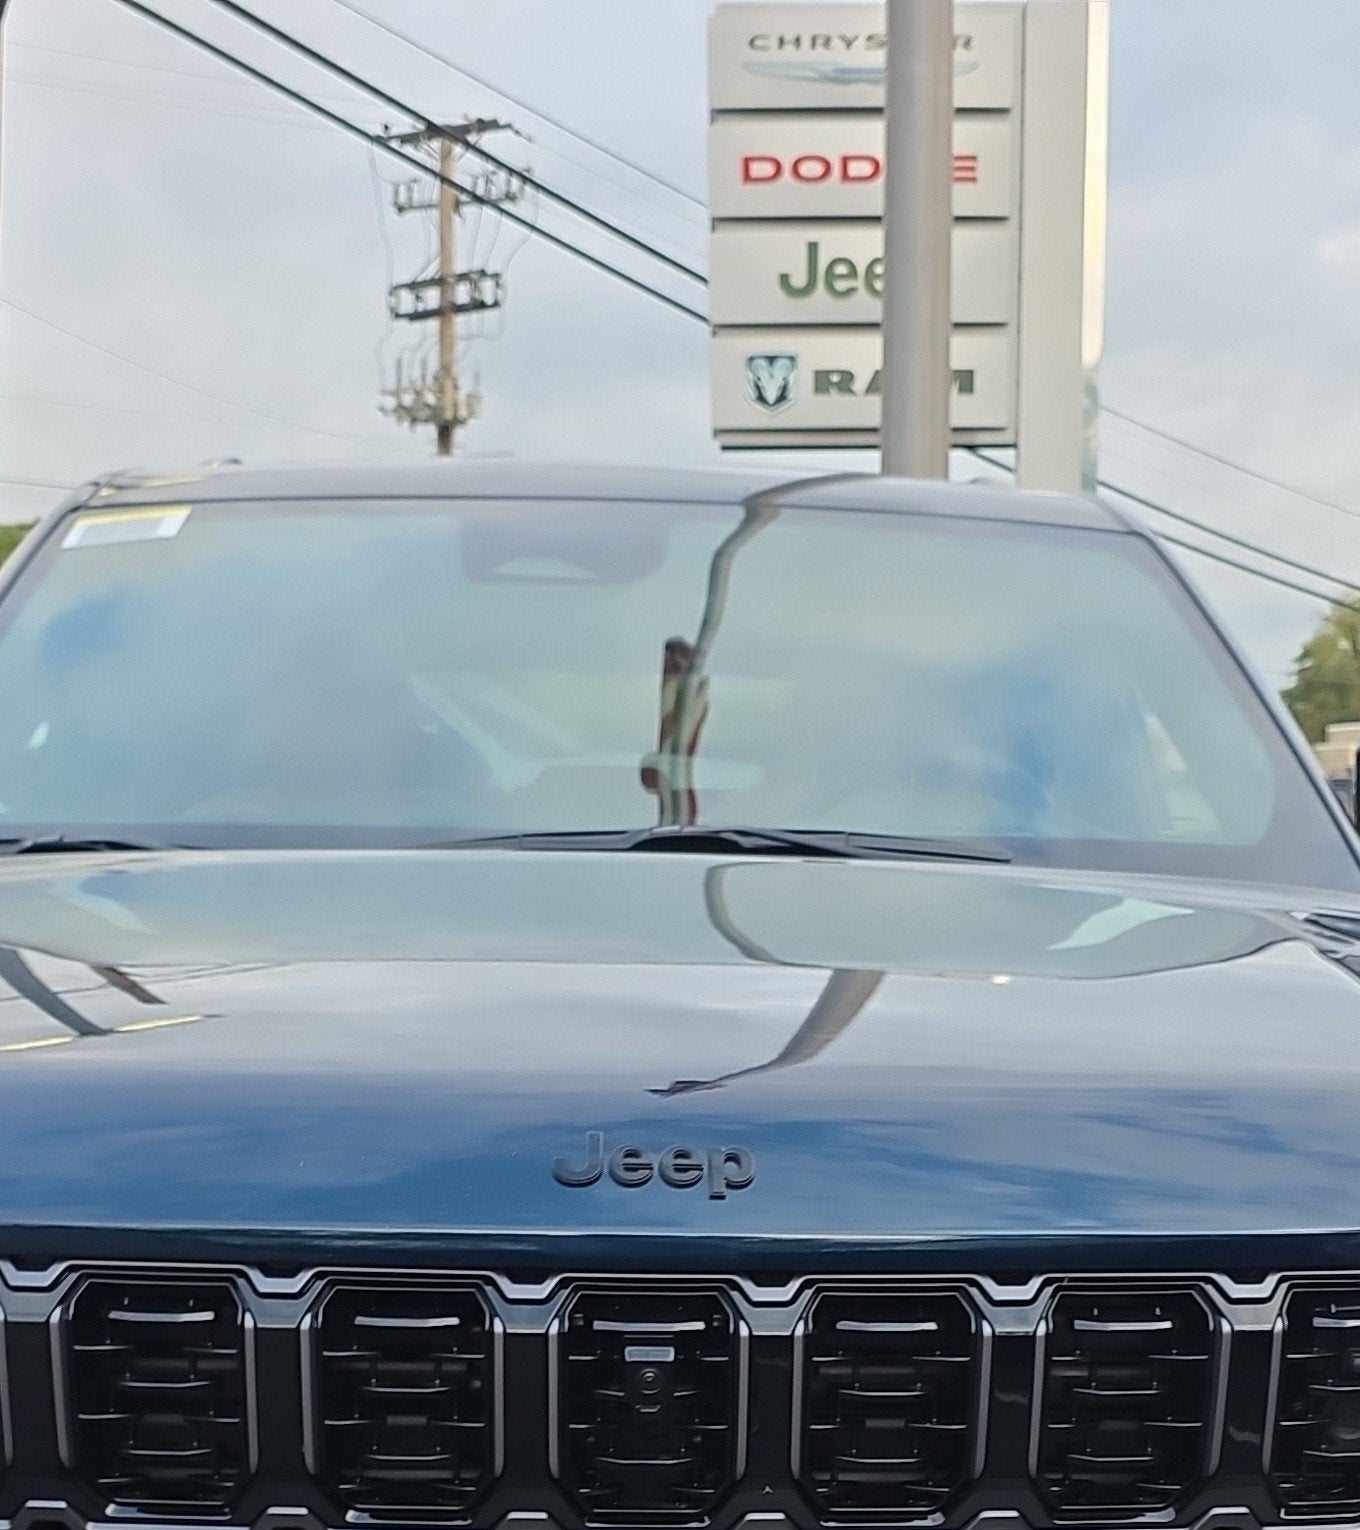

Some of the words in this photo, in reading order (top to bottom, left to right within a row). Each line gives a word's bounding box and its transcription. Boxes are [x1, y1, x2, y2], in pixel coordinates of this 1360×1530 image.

[748, 33, 973, 51] CHRYSR
[742, 155, 978, 184] DODE
[778, 241, 885, 299] Jee
[552, 1131, 756, 1201] Jeep
